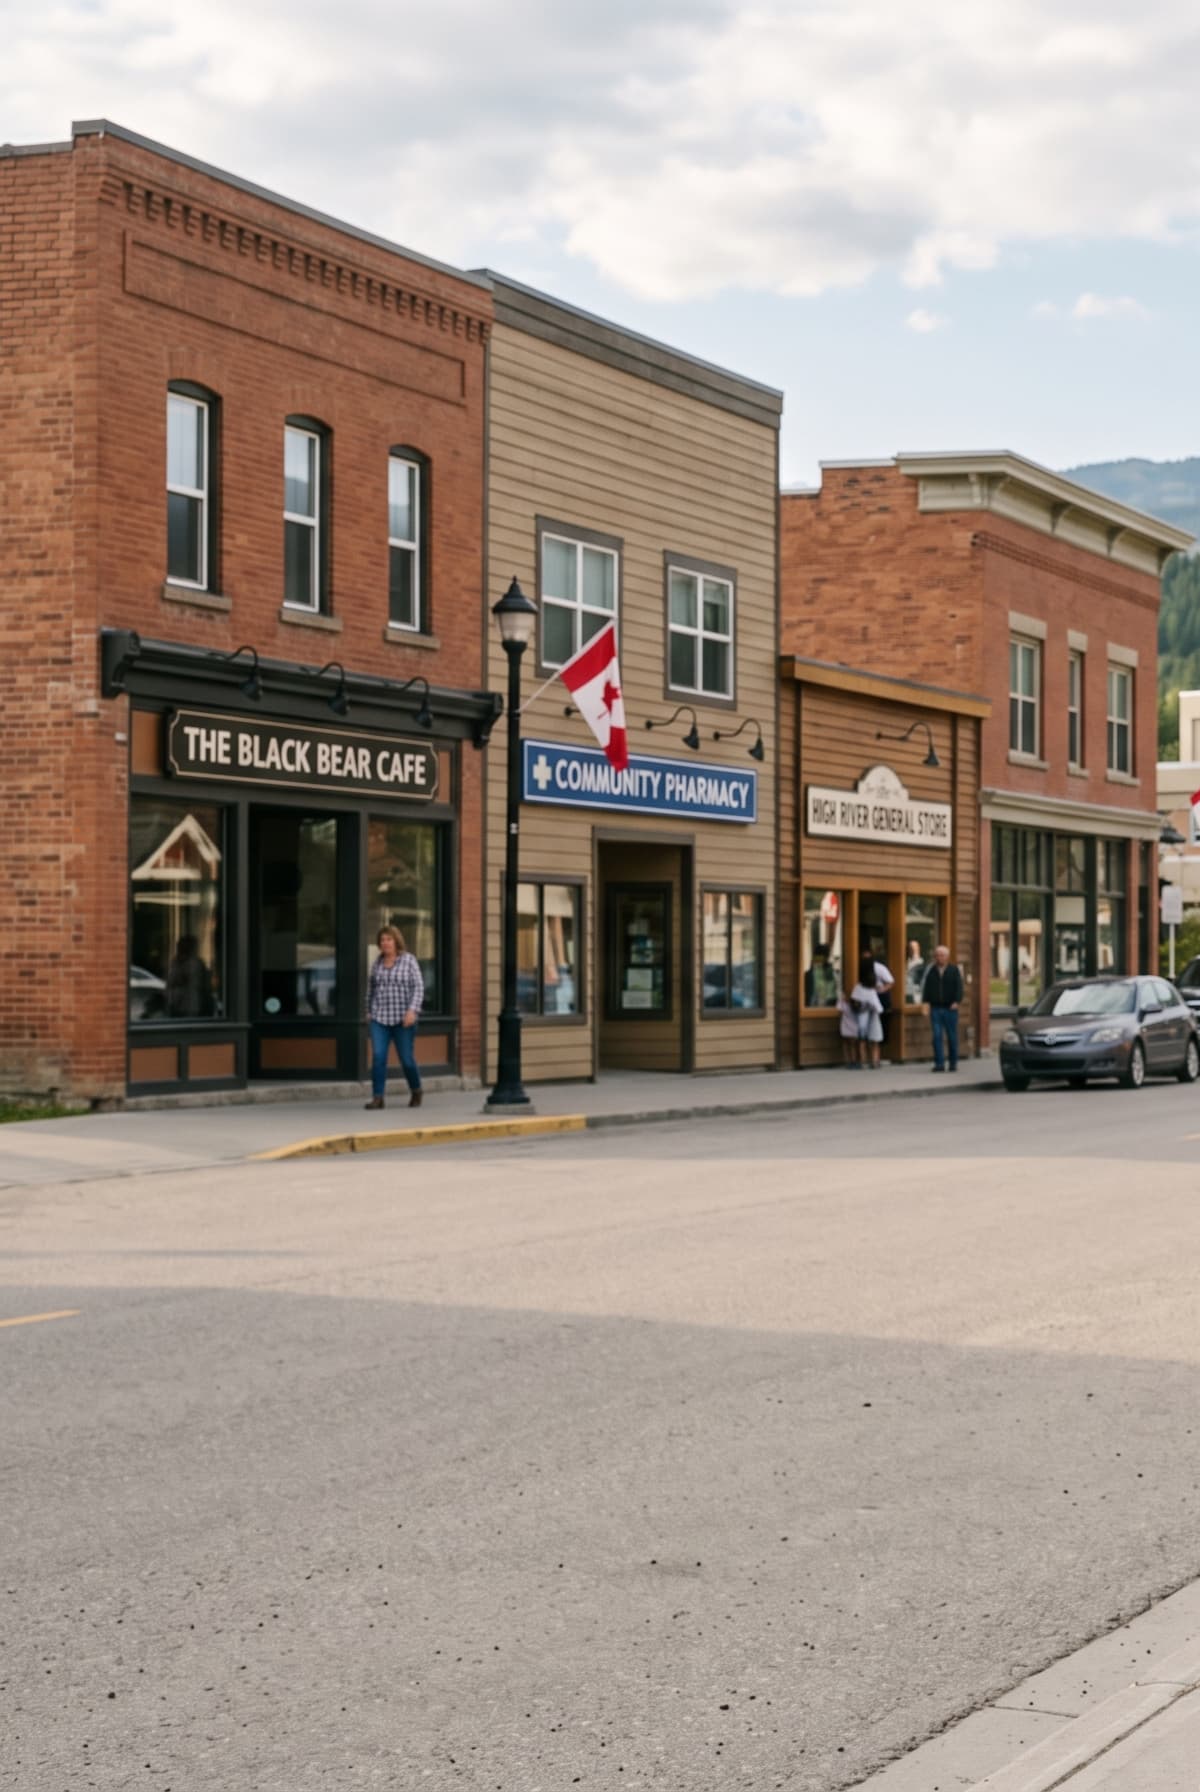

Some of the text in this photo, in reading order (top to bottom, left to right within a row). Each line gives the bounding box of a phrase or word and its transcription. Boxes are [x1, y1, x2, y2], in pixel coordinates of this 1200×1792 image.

[184, 726, 426, 785] THE BLACK BEAR CAFE
[555, 759, 749, 809] COMMUNITY PHARMACY
[812, 797, 947, 838] HIGH RIVER GENERAL STORE
